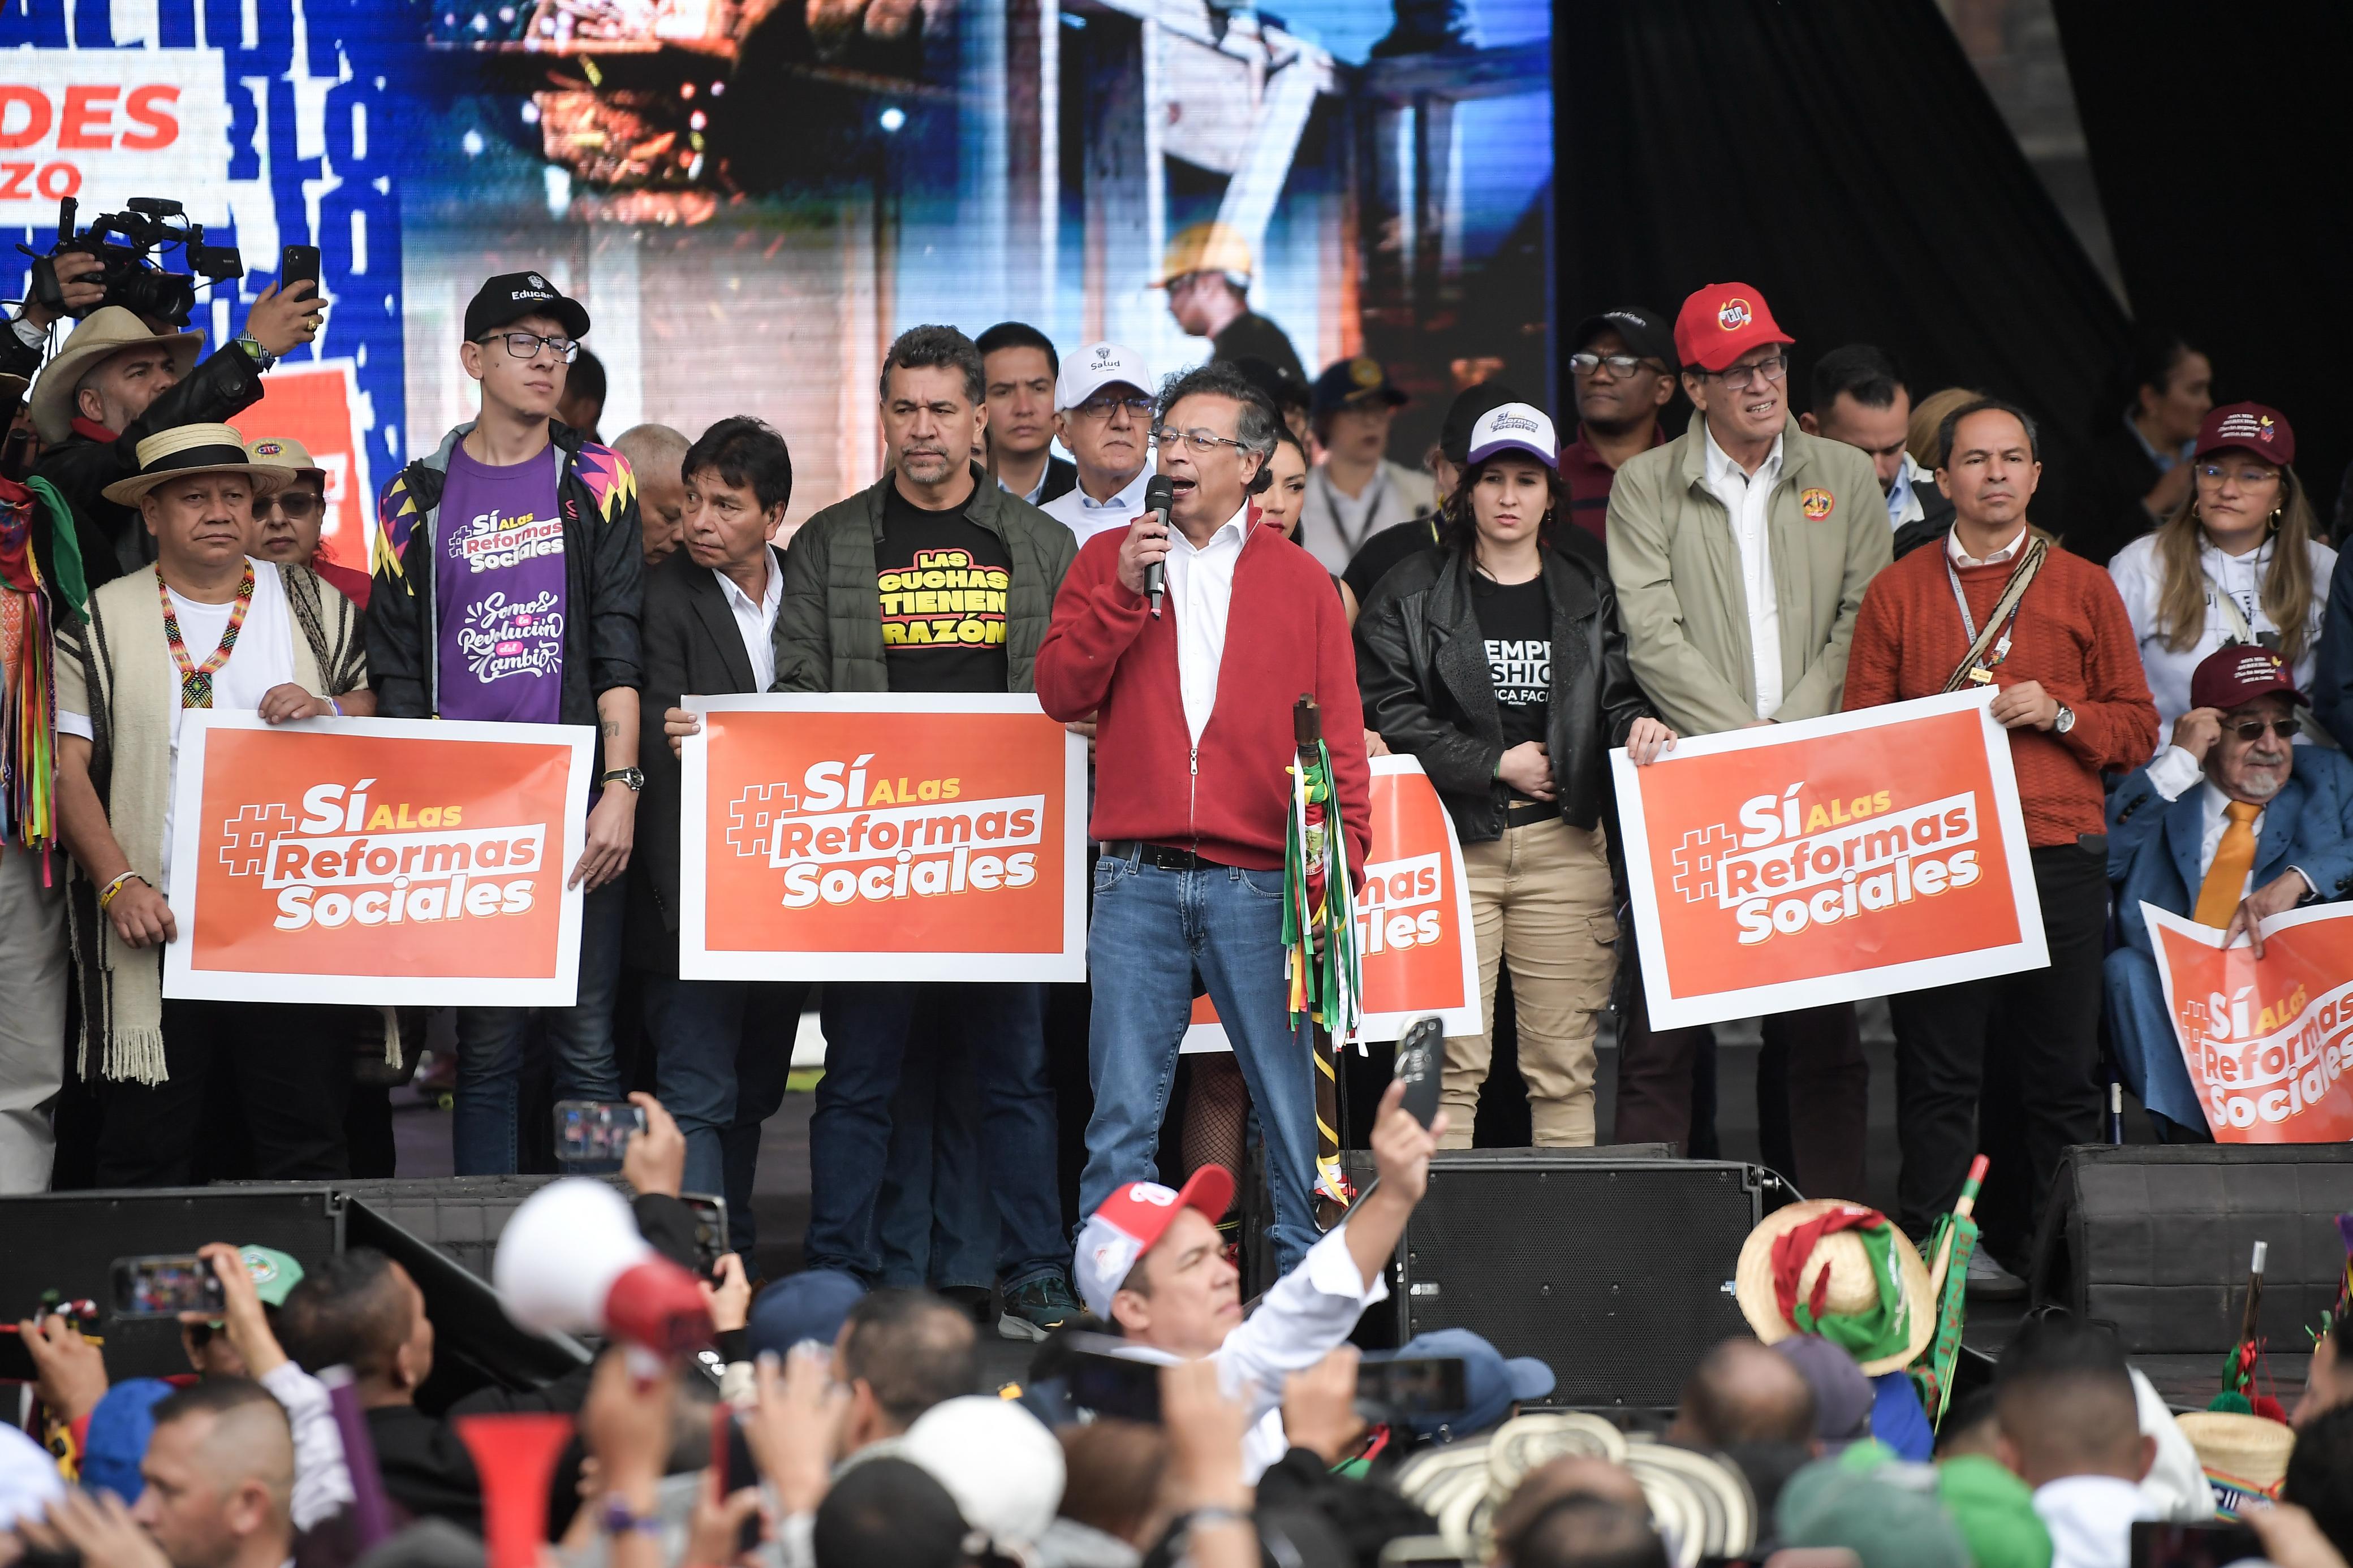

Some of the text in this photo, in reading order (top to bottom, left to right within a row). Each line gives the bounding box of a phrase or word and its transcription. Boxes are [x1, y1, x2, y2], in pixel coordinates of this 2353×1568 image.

[1091, 360, 1121, 370] Salud
[1492, 424, 1536, 433] Sociales
[467, 522, 562, 555] Reformas
[469, 538, 564, 573] Sociales
[920, 552, 967, 568] LAS
[878, 570, 1009, 592] CUCHAS
[480, 591, 558, 629] Somos
[880, 590, 1006, 615] TIENEN
[457, 612, 563, 655] Revolución
[882, 612, 1006, 644] RAZÓN
[477, 640, 559, 684] Cambio
[1494, 689, 1549, 702] CA FAC
[779, 809, 1035, 858] Reformas
[1725, 806, 1968, 899] Reformas
[272, 835, 536, 880] Reformas
[781, 846, 1038, 910] Sociales
[1737, 849, 1983, 946] Sociales
[273, 874, 536, 931] Sociales
[2204, 992, 2353, 1082] Reformas
[2210, 1033, 2353, 1130] Sociales
